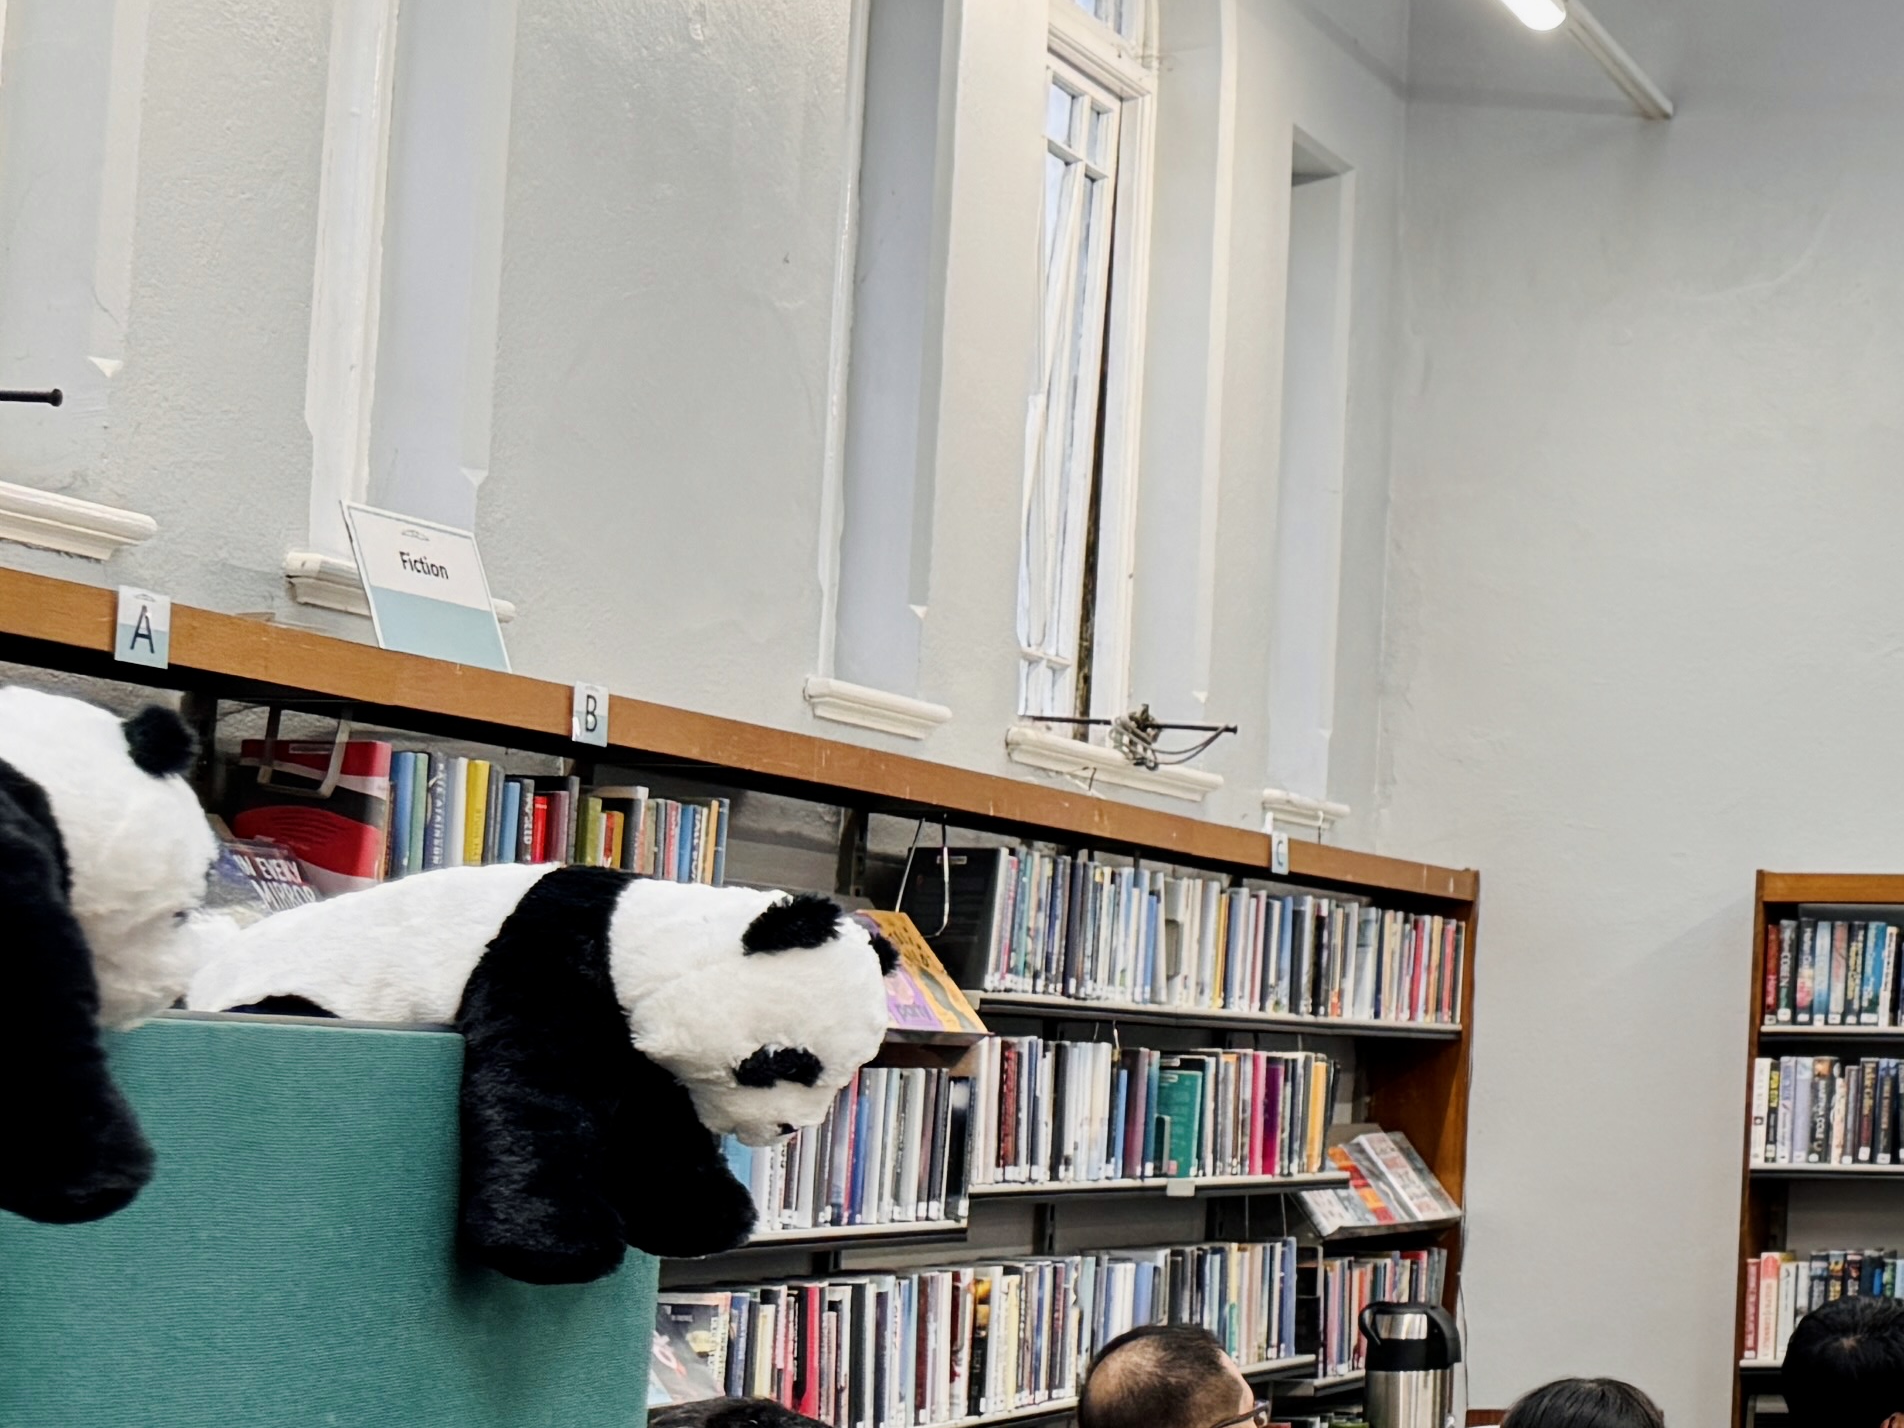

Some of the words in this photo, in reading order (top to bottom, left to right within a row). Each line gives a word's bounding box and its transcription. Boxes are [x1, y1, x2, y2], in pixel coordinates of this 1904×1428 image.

[399, 549, 450, 582] Fiction
[129, 604, 156, 655] A
[584, 693, 599, 734] B
[233, 854, 257, 877] IN
[255, 856, 303, 884] EVERY
[250, 878, 317, 913] MIRROR
